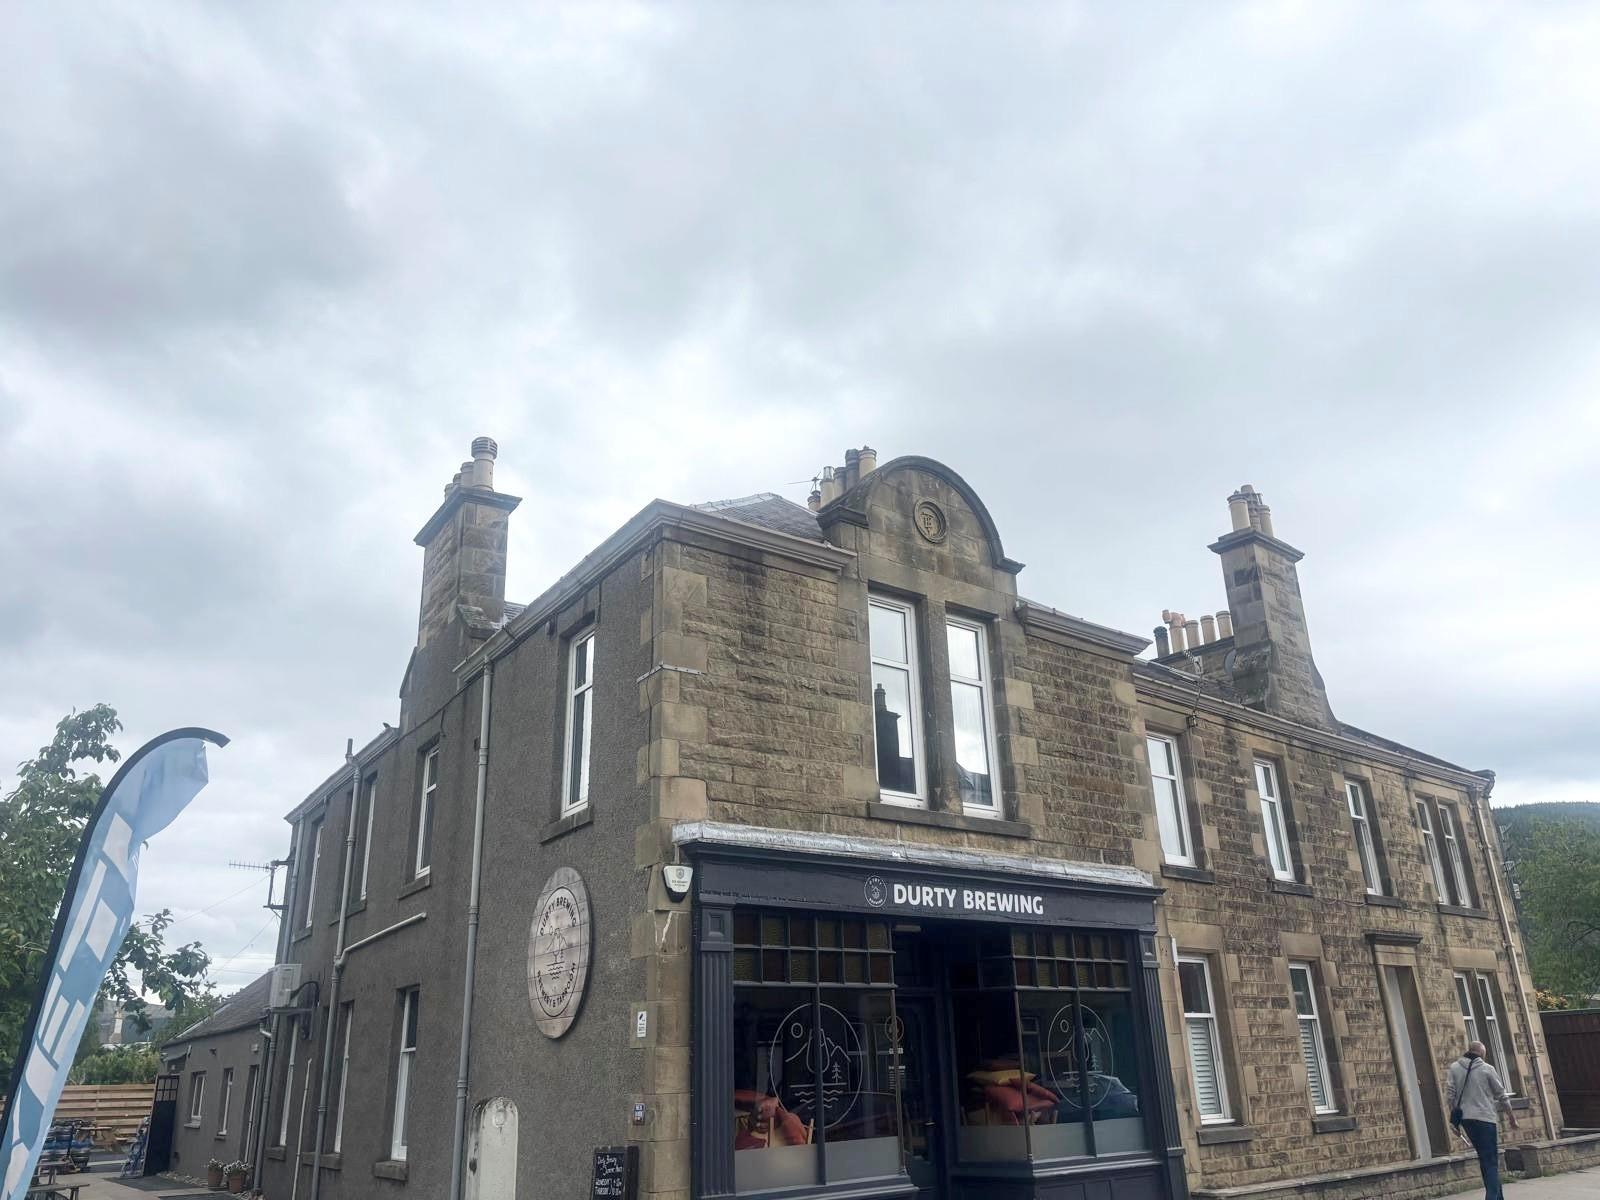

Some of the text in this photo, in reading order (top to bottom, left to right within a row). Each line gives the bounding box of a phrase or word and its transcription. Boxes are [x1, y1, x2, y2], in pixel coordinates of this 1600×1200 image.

[540, 896, 577, 936] DURTY BREWING
[893, 884, 1044, 915] DURTY BREWING
